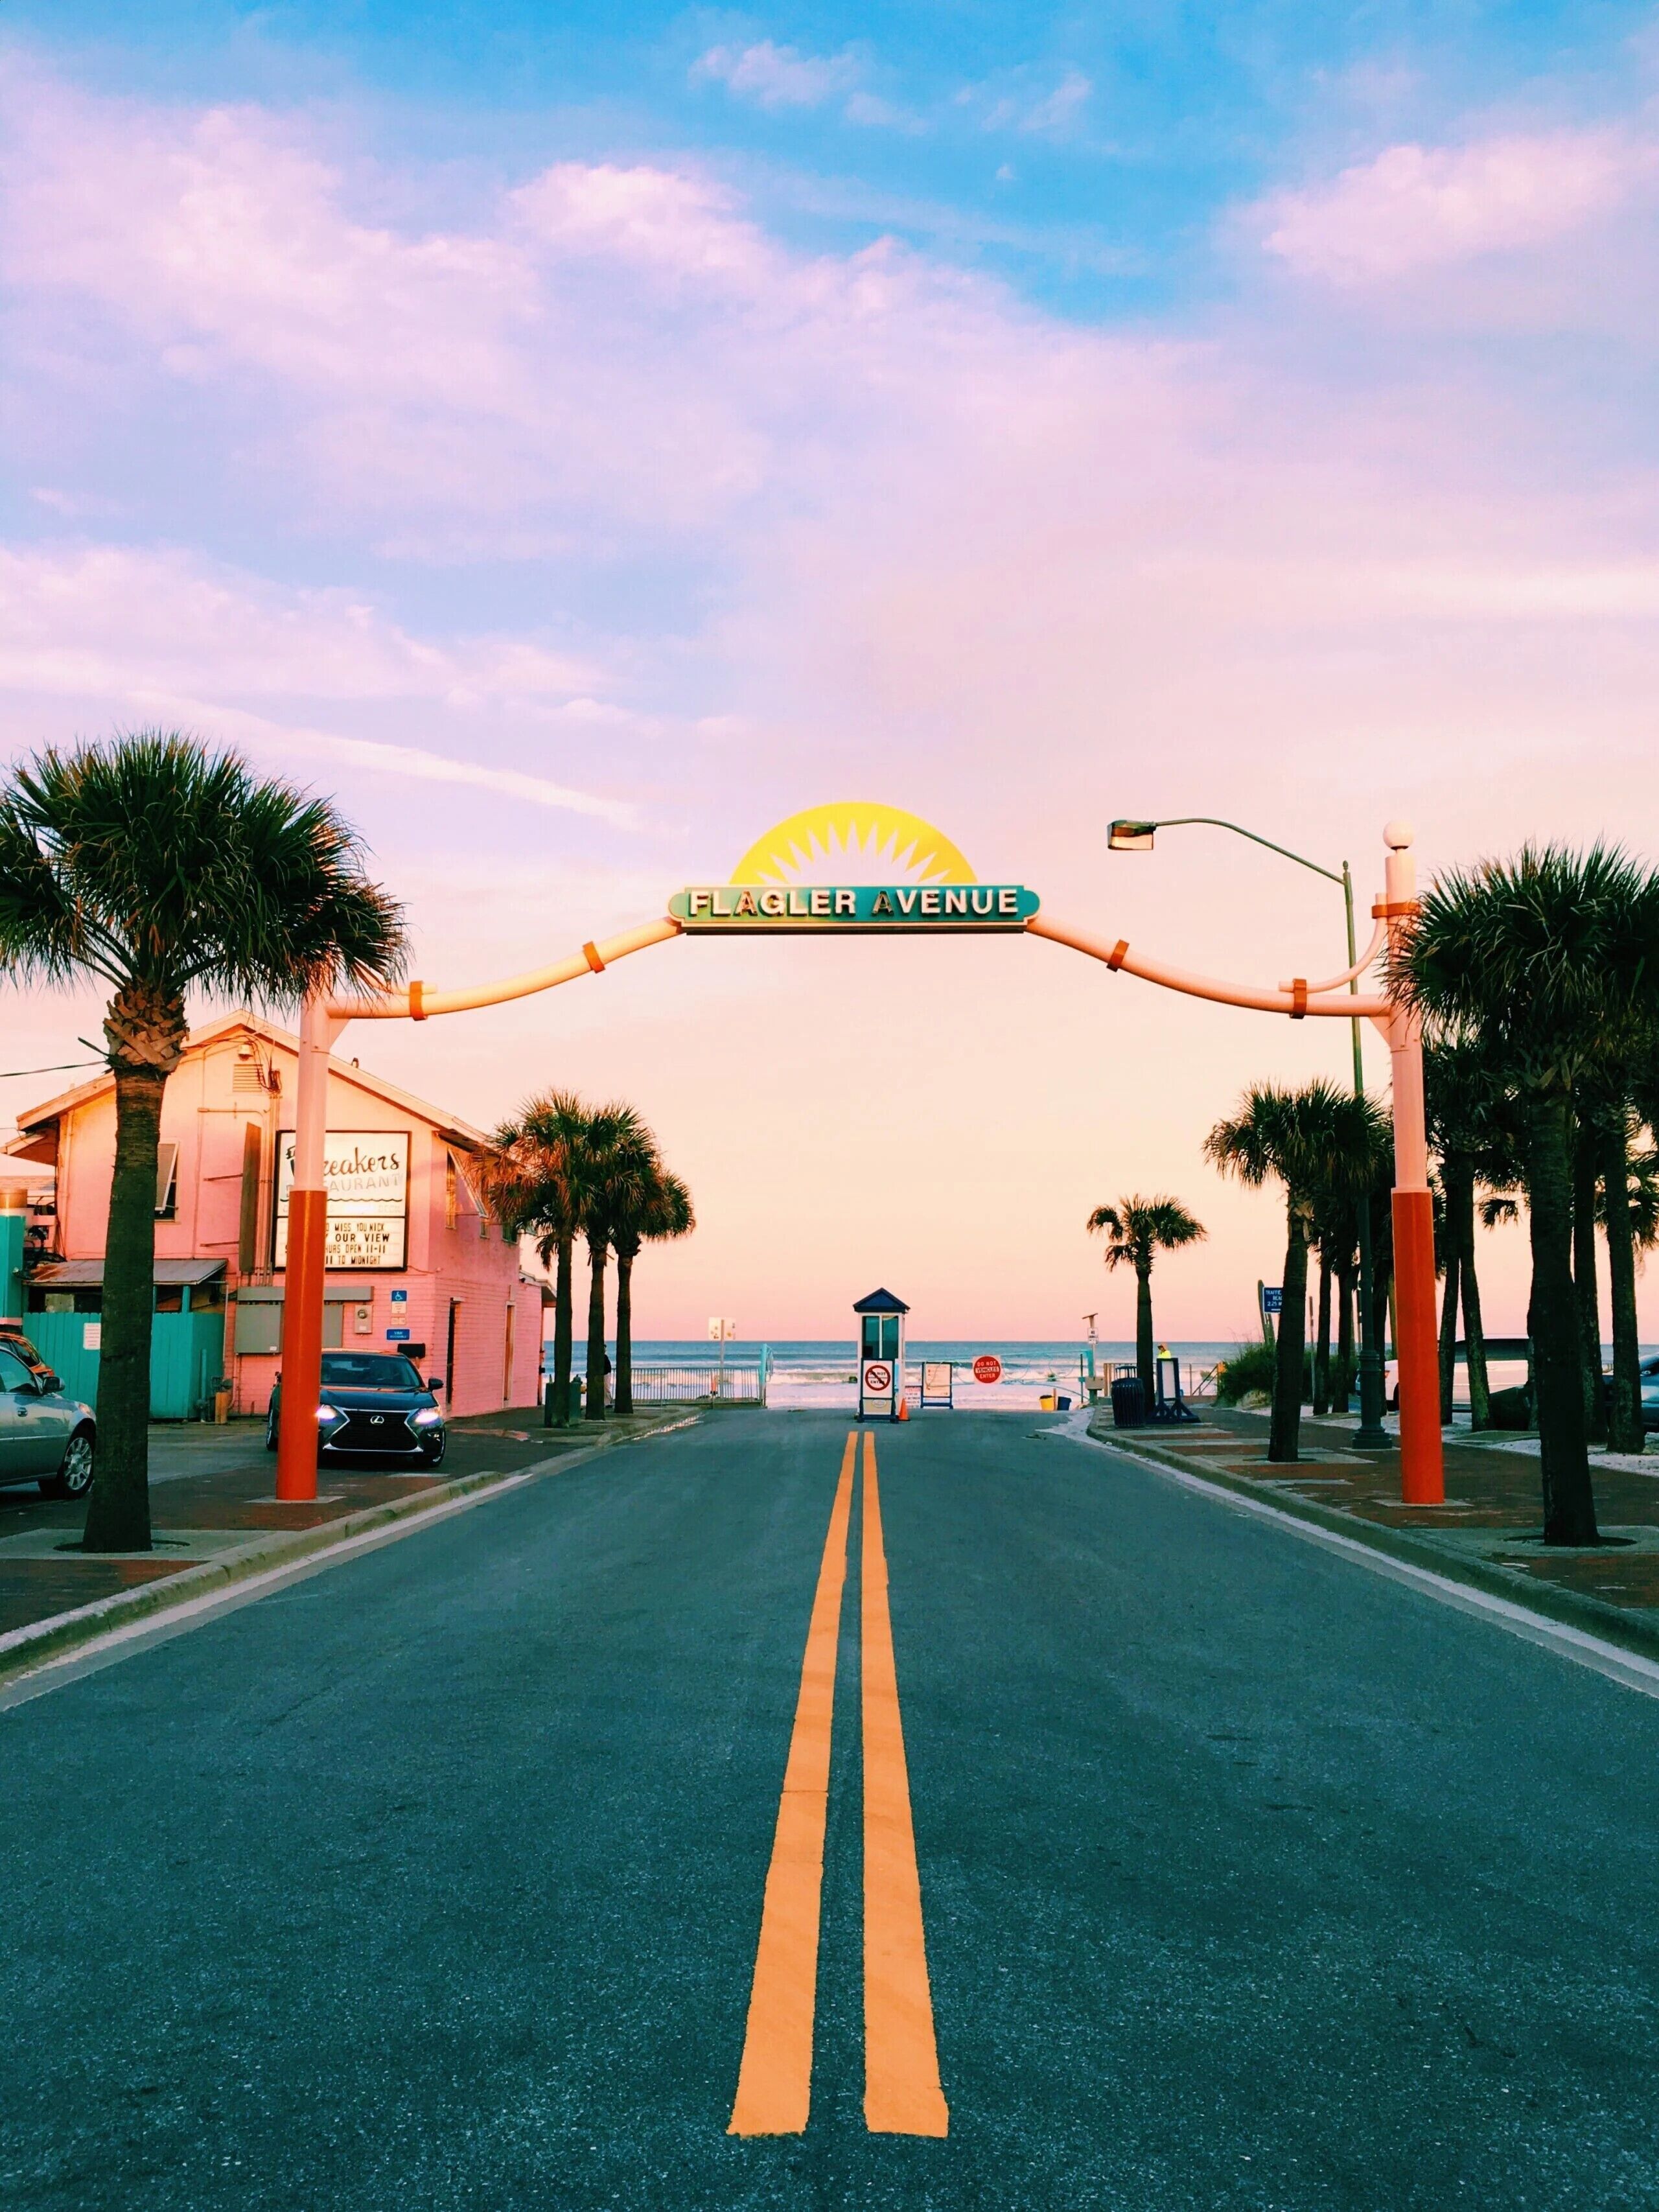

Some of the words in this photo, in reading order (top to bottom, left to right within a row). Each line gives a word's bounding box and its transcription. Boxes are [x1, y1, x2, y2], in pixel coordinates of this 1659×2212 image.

[690, 889, 857, 916] FLAGLER
[872, 889, 1019, 915] AVENUE
[357, 1223, 367, 1231] YOU
[336, 1233, 356, 1242] OUR
[365, 1233, 390, 1242] VIEW
[345, 1244, 362, 1253] OPEN
[338, 1255, 346, 1264] TO
[351, 1255, 381, 1265] MIDNIGHT
